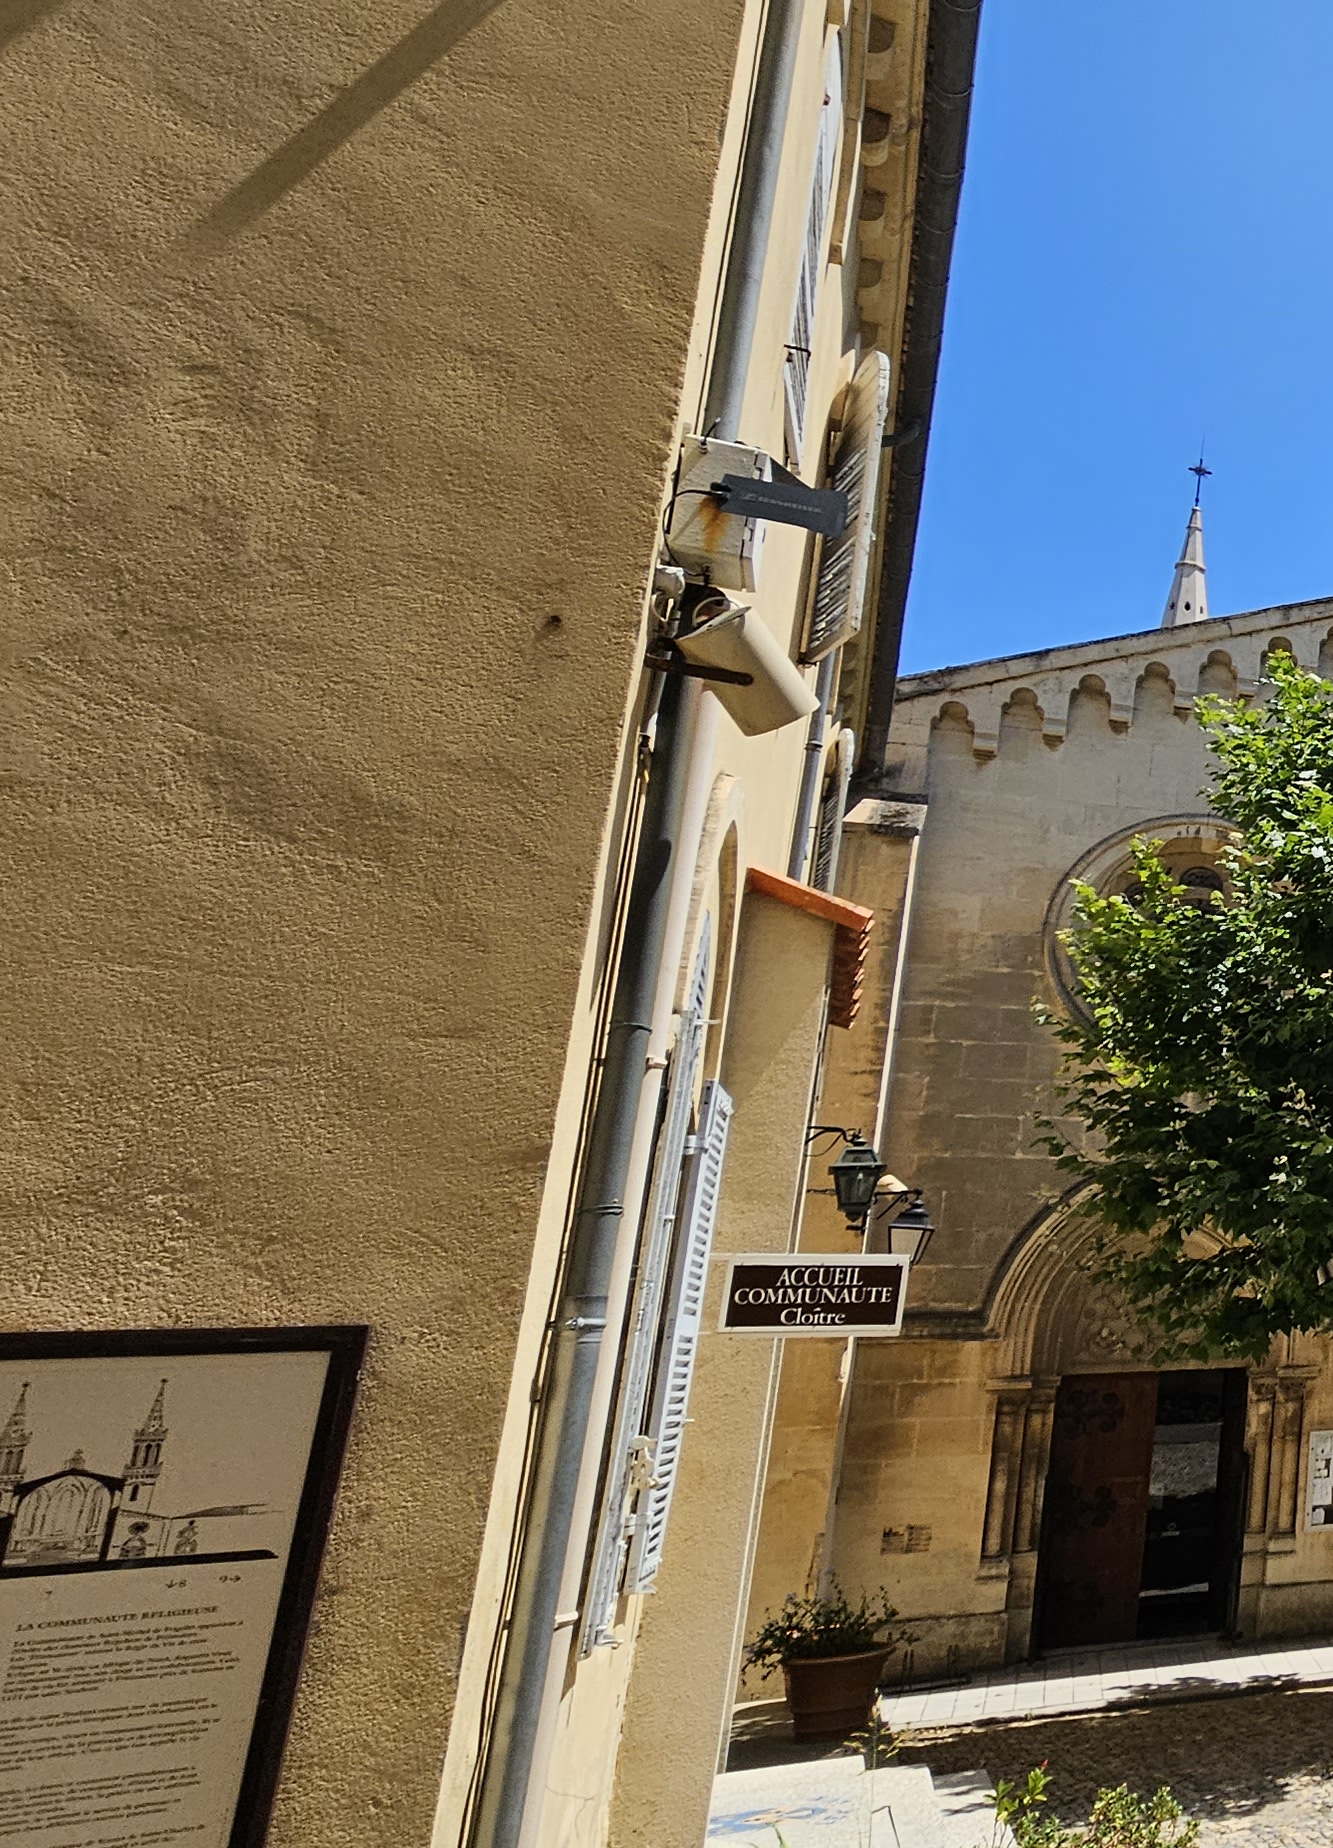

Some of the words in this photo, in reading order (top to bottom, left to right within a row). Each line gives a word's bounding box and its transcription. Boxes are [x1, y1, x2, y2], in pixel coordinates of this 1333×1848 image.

[775, 1267, 863, 1287] ACCUEIL
[734, 1287, 893, 1305] COMMUNAUTE
[780, 1307, 846, 1325] Cloître
